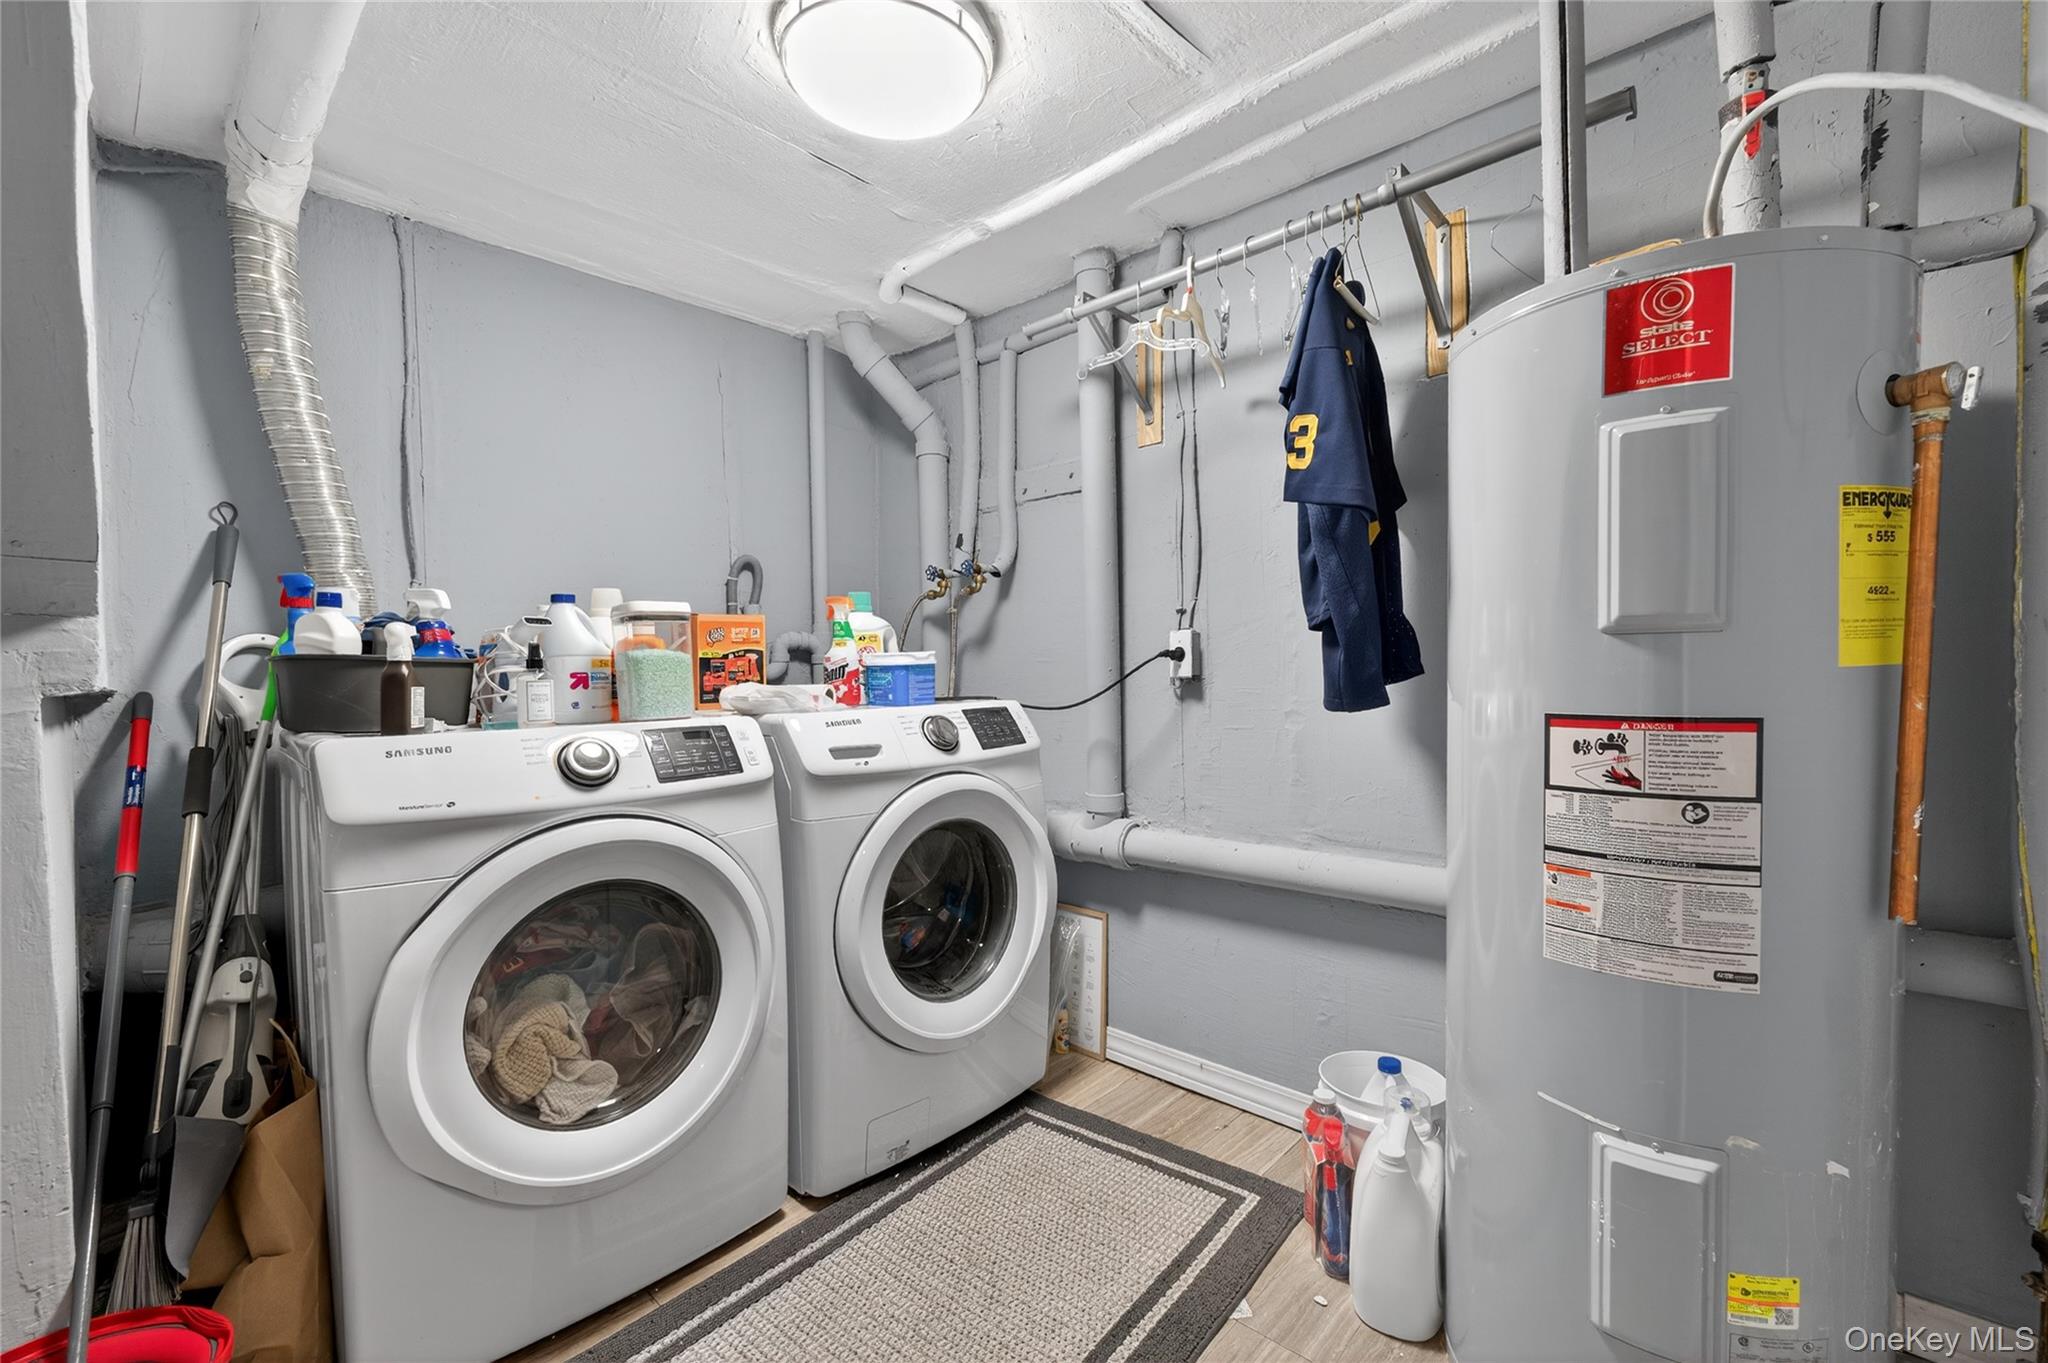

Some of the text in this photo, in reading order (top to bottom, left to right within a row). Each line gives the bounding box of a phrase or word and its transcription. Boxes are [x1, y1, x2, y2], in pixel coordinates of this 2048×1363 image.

[1640, 320, 1694, 338] state
[1622, 329, 1712, 355] SELECT
[1287, 413, 1319, 470] 3
[1876, 530, 1896, 542] 555
[1633, 722, 1674, 730] DANGER
[385, 746, 452, 759] SAMSUNG
